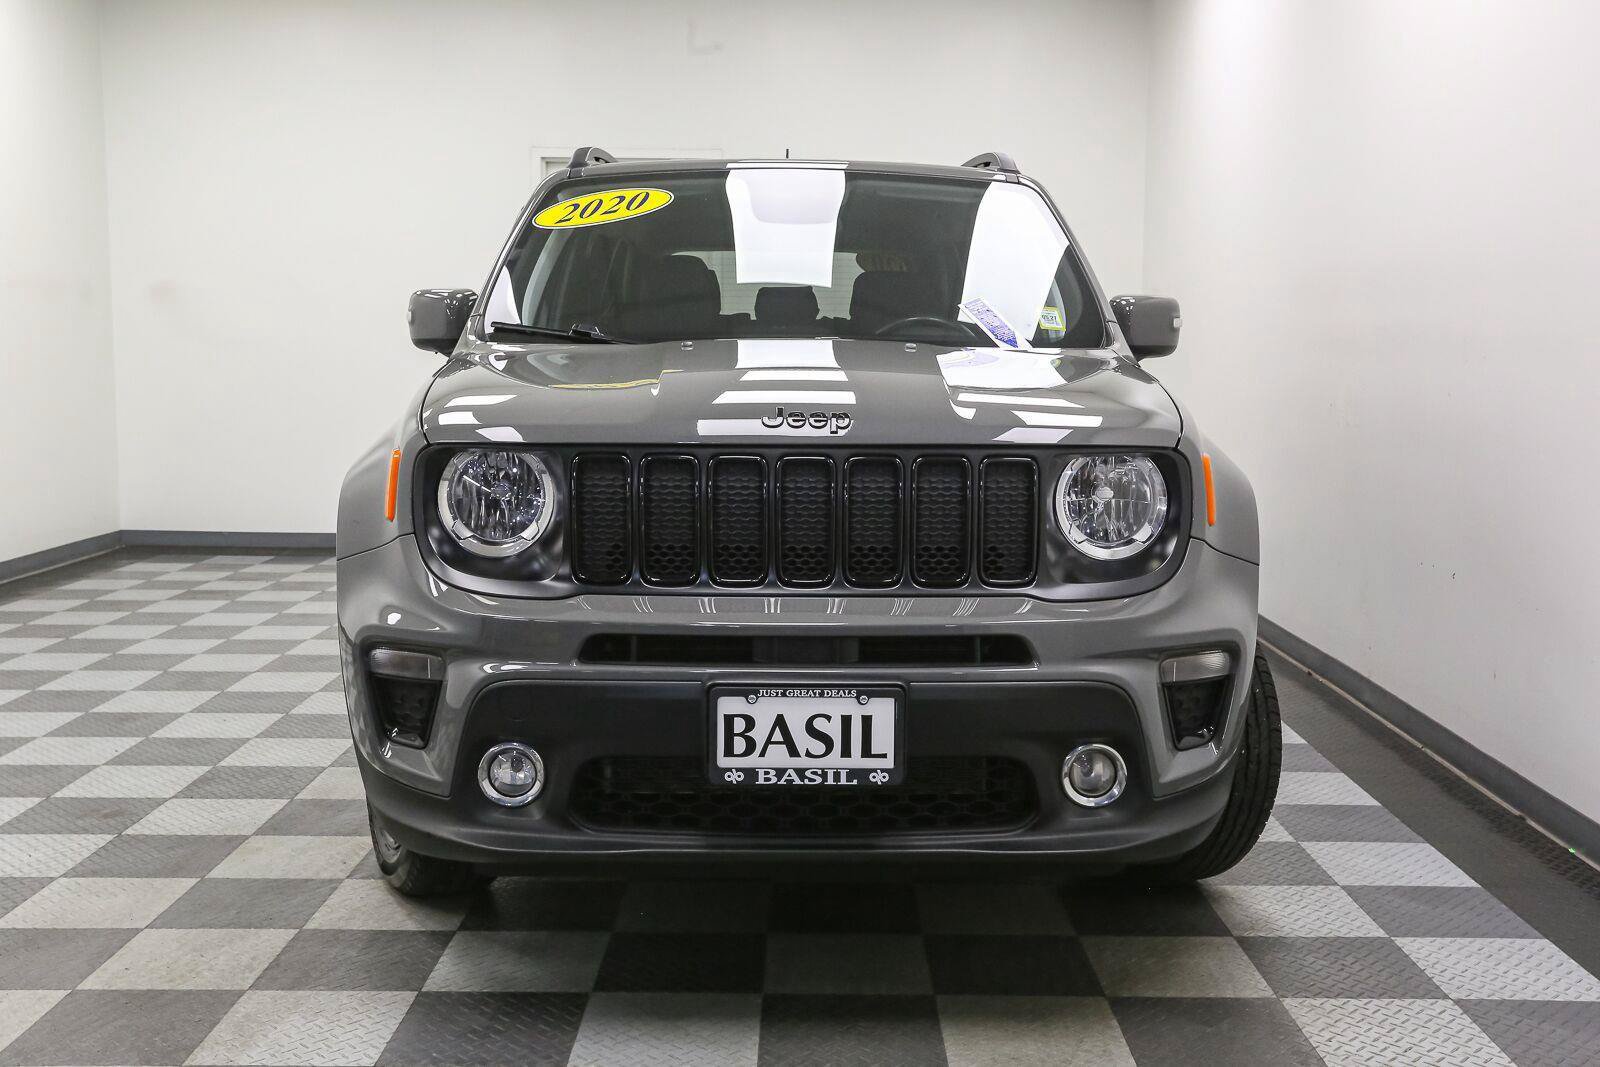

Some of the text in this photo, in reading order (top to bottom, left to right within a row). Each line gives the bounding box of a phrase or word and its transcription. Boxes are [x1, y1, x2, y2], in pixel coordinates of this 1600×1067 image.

[554, 191, 650, 224] 2020
[761, 406, 852, 434] Jeep
[757, 689, 857, 697] JUST GREAT DEALS
[723, 713, 888, 759] BASIL
[755, 768, 858, 785] BASIL
